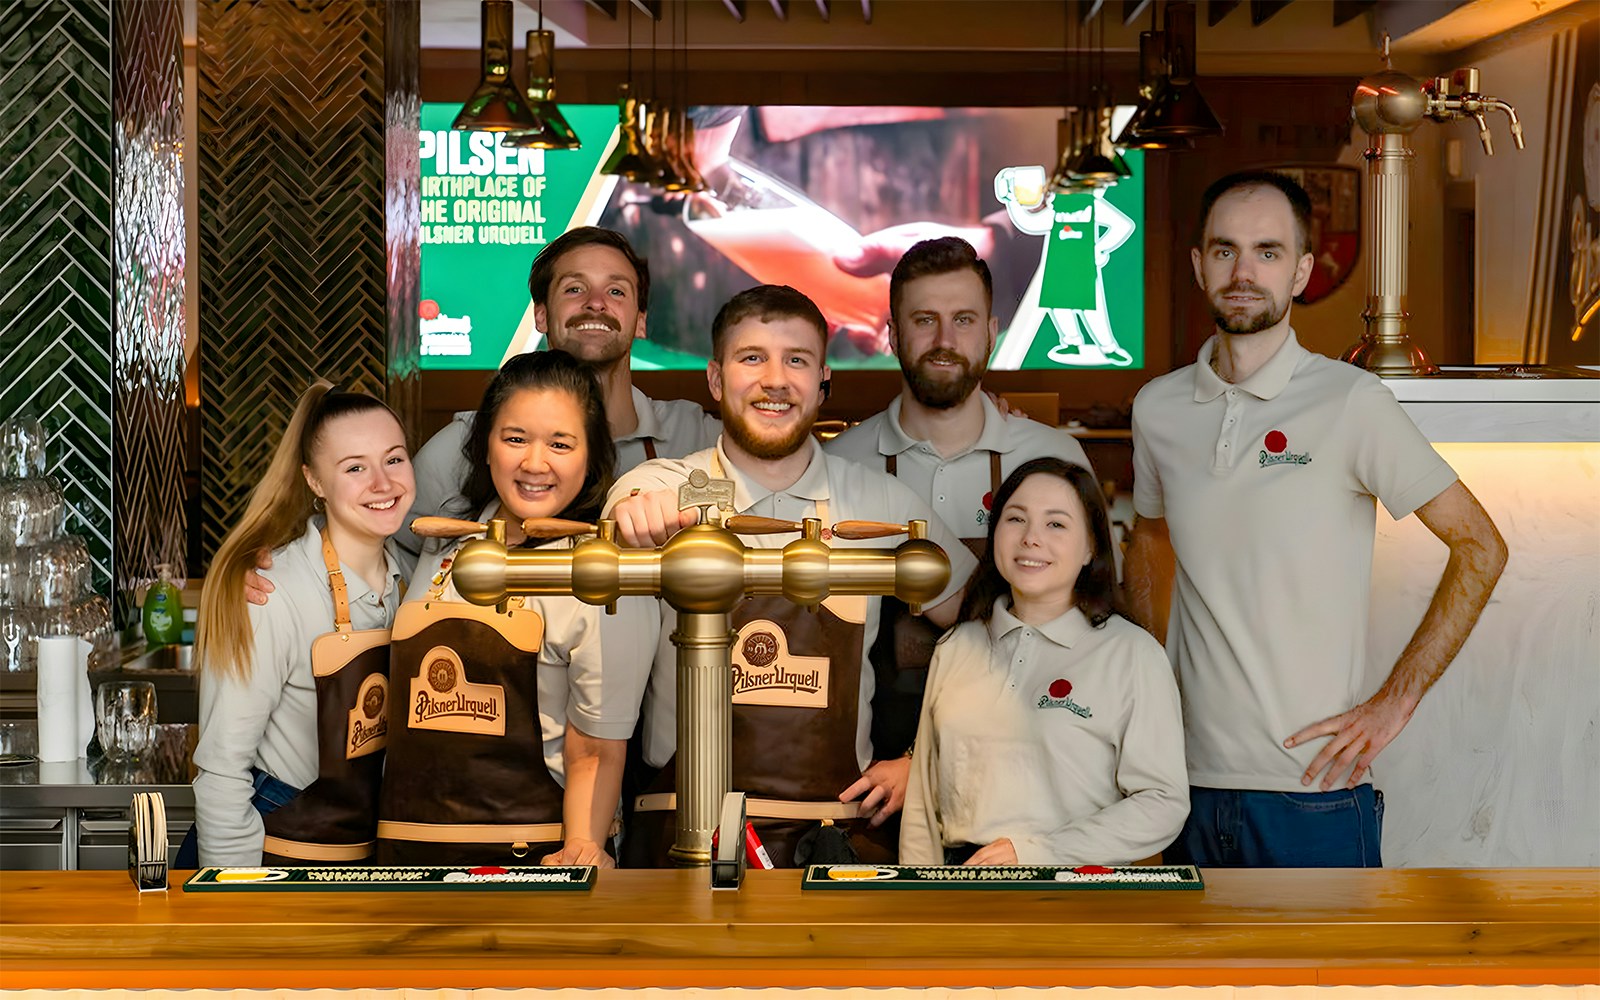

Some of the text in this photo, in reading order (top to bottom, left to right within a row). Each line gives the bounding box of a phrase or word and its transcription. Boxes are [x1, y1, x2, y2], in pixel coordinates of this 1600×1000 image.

[419, 130, 545, 175] PILSEN
[421, 175, 547, 198] IRTHPLACE OF
[421, 199, 546, 223] HE ORIGINAL
[419, 225, 547, 245] ILSNER URQUELL
[732, 663, 775, 695] Pilsner
[415, 690, 459, 723] Pilsner
